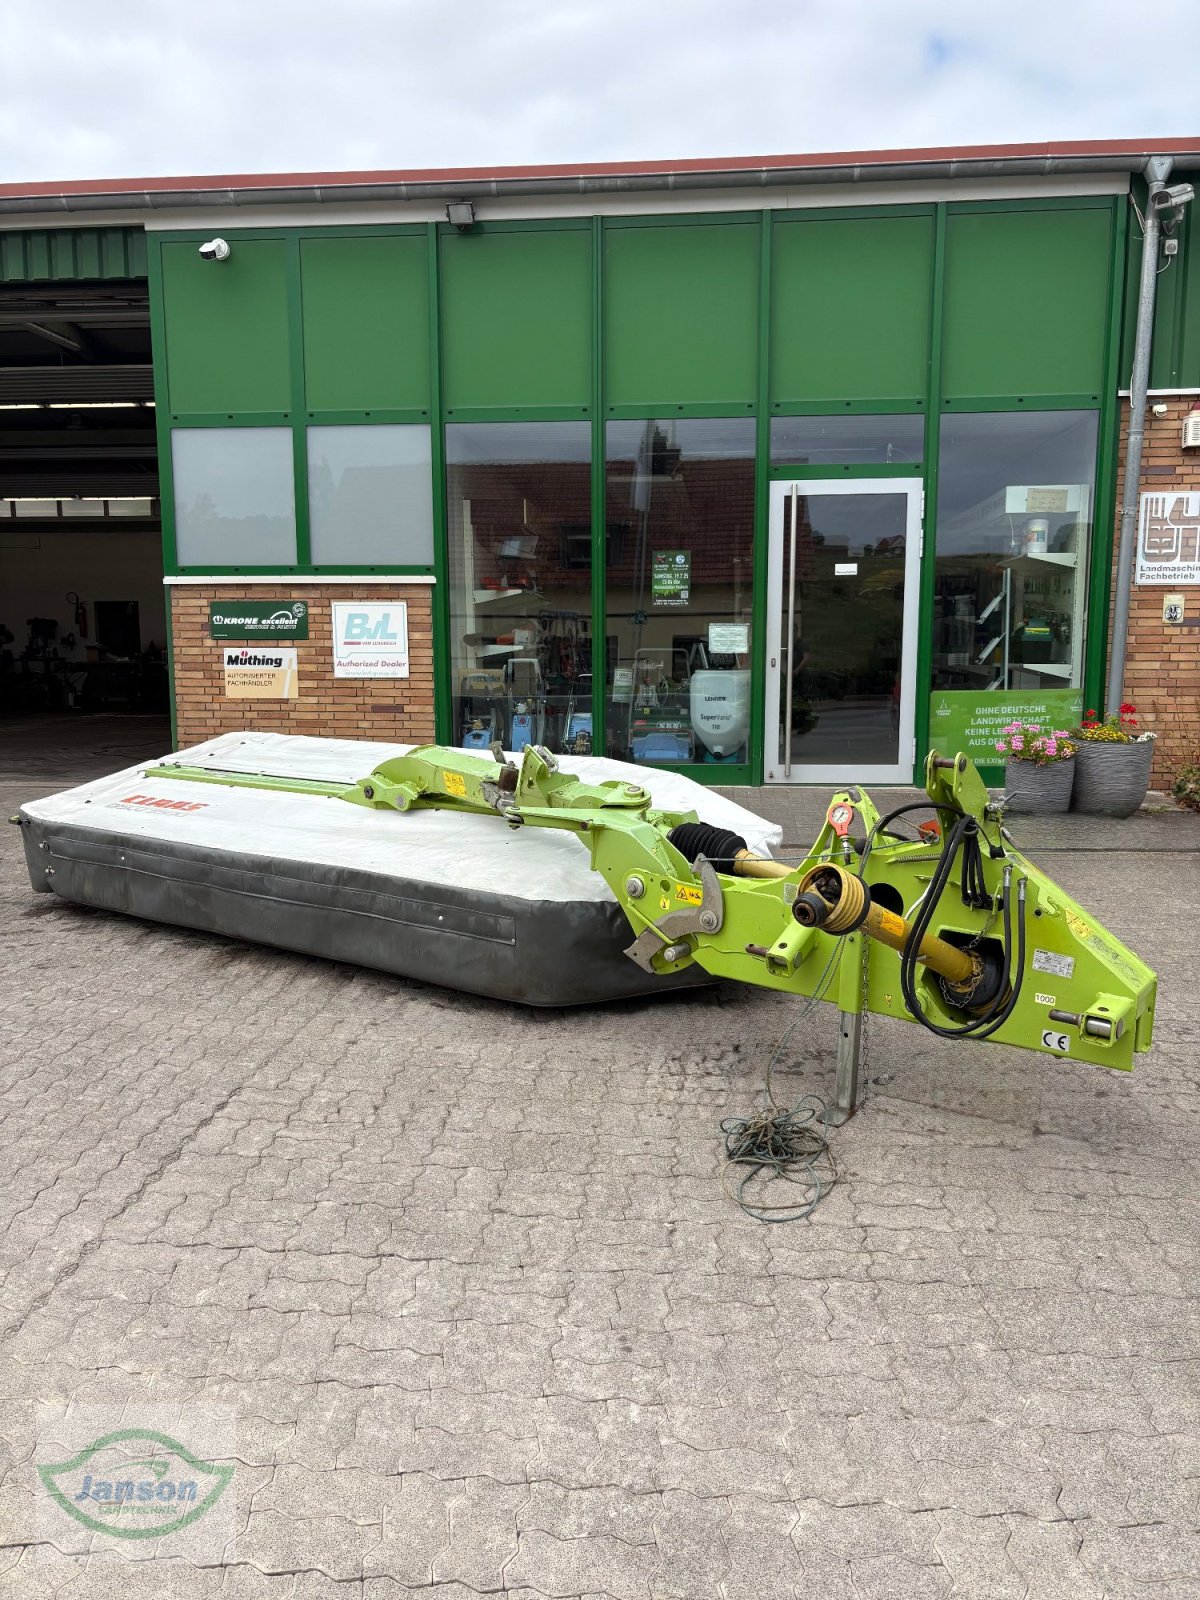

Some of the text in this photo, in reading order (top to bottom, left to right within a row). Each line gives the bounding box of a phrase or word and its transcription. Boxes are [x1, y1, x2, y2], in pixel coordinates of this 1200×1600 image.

[1140, 572, 1195, 580] Fachbetrieb
[223, 616, 298, 625] KRONE excellent
[344, 613, 398, 640] BvL
[227, 650, 283, 668] Müthing
[336, 660, 407, 668] Authorized Dealer
[227, 679, 273, 687] FACHHÄNDLER
[975, 705, 1047, 714] OHNE DEUTSCHE
[970, 716, 1051, 725] LANDWIRTSCHAFT
[965, 728, 990, 736] KEINE
[968, 738, 986, 746] AUS
[119, 794, 210, 811] CLAAS
[1035, 994, 1055, 1004] 1000
